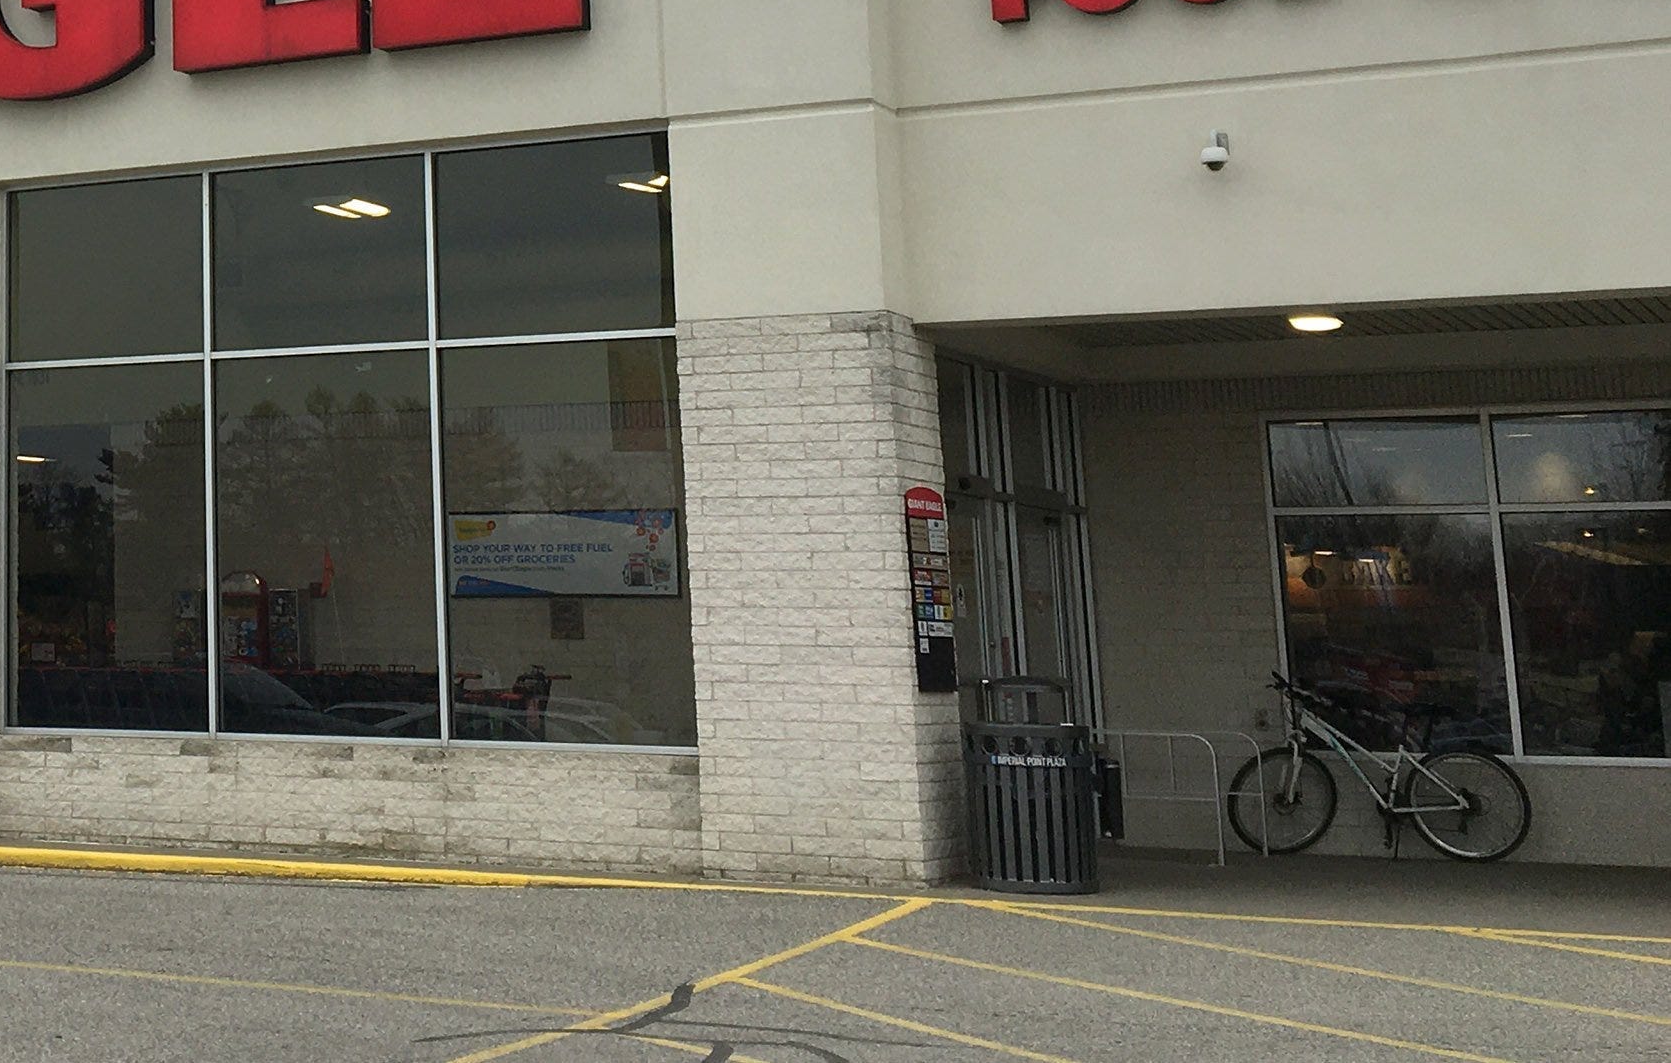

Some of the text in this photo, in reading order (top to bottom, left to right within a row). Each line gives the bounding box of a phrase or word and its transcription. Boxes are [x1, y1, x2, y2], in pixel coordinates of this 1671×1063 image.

[452, 542, 613, 554] SHOP YOUR WAY TO FREE FUEL
[453, 553, 576, 565] OR 20% OFF GROCERIES
[997, 755, 1067, 767] IMPERIAL POINT PLAZA
